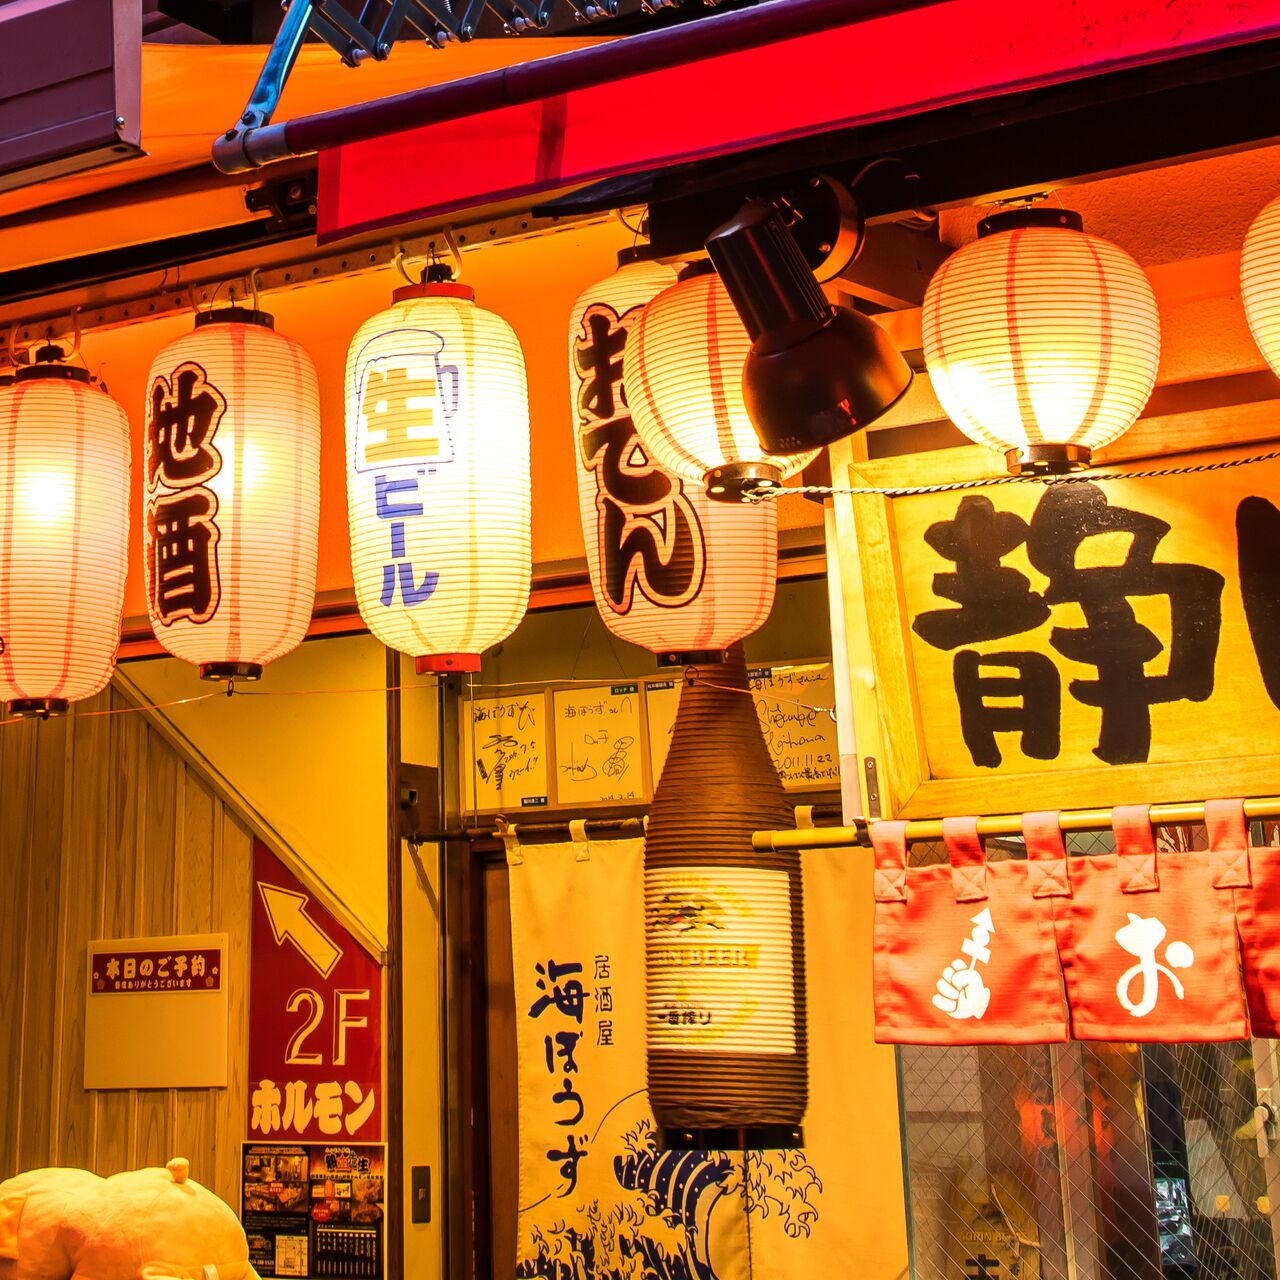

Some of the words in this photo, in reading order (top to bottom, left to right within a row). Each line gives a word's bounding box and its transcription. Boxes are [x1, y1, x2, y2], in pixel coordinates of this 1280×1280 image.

[145, 362, 227, 626] 地酒
[363, 368, 440, 608] 生ビール
[106, 955, 206, 980] 本日のご予約
[689, 948, 750, 966] BEER
[285, 988, 371, 1067] 2F
[594, 954, 615, 1047] 居酒屋
[251, 1079, 376, 1136] ホルモン
[528, 959, 590, 1198] 海ぼうず
